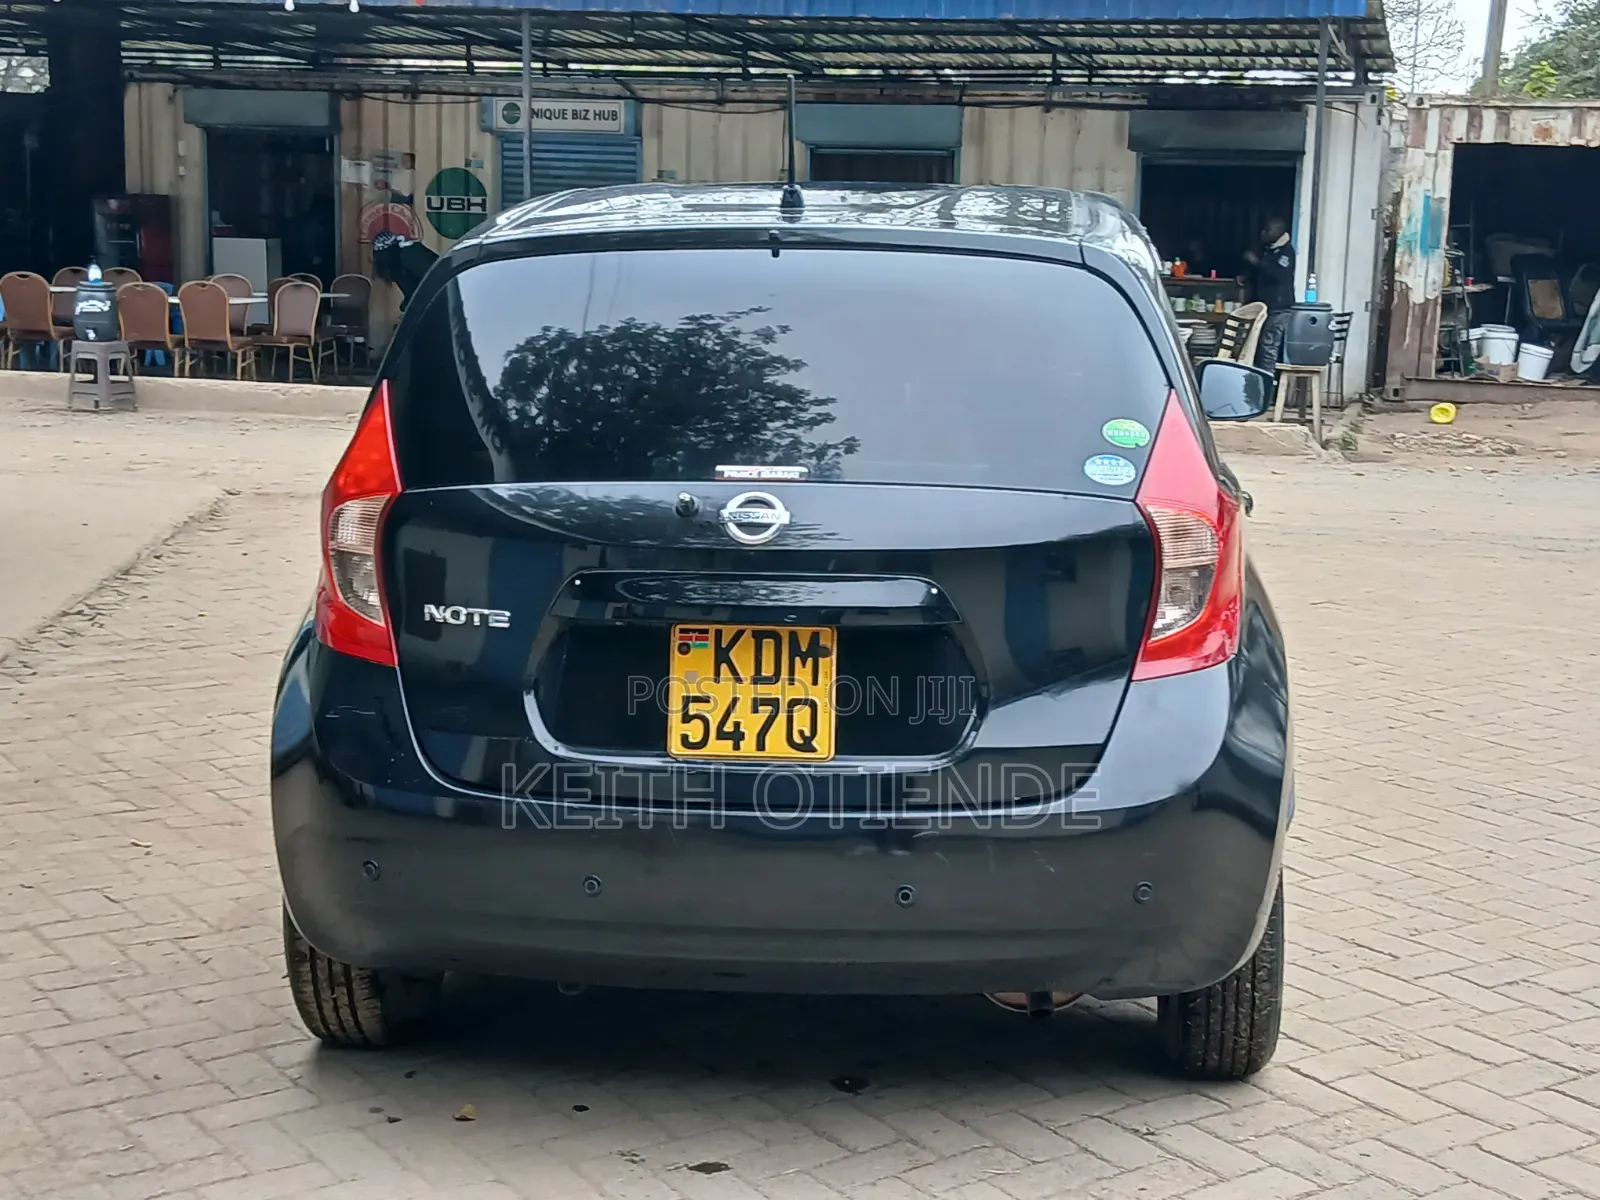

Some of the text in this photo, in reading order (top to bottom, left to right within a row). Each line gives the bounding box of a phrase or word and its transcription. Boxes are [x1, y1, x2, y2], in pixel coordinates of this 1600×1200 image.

[529, 108, 619, 122] NIQUE BIZ HUB
[426, 196, 487, 212] UBH
[728, 510, 782, 521] NISSAN
[423, 603, 511, 628] NOTE
[713, 628, 821, 686] KDM
[679, 694, 819, 753] 547Q
